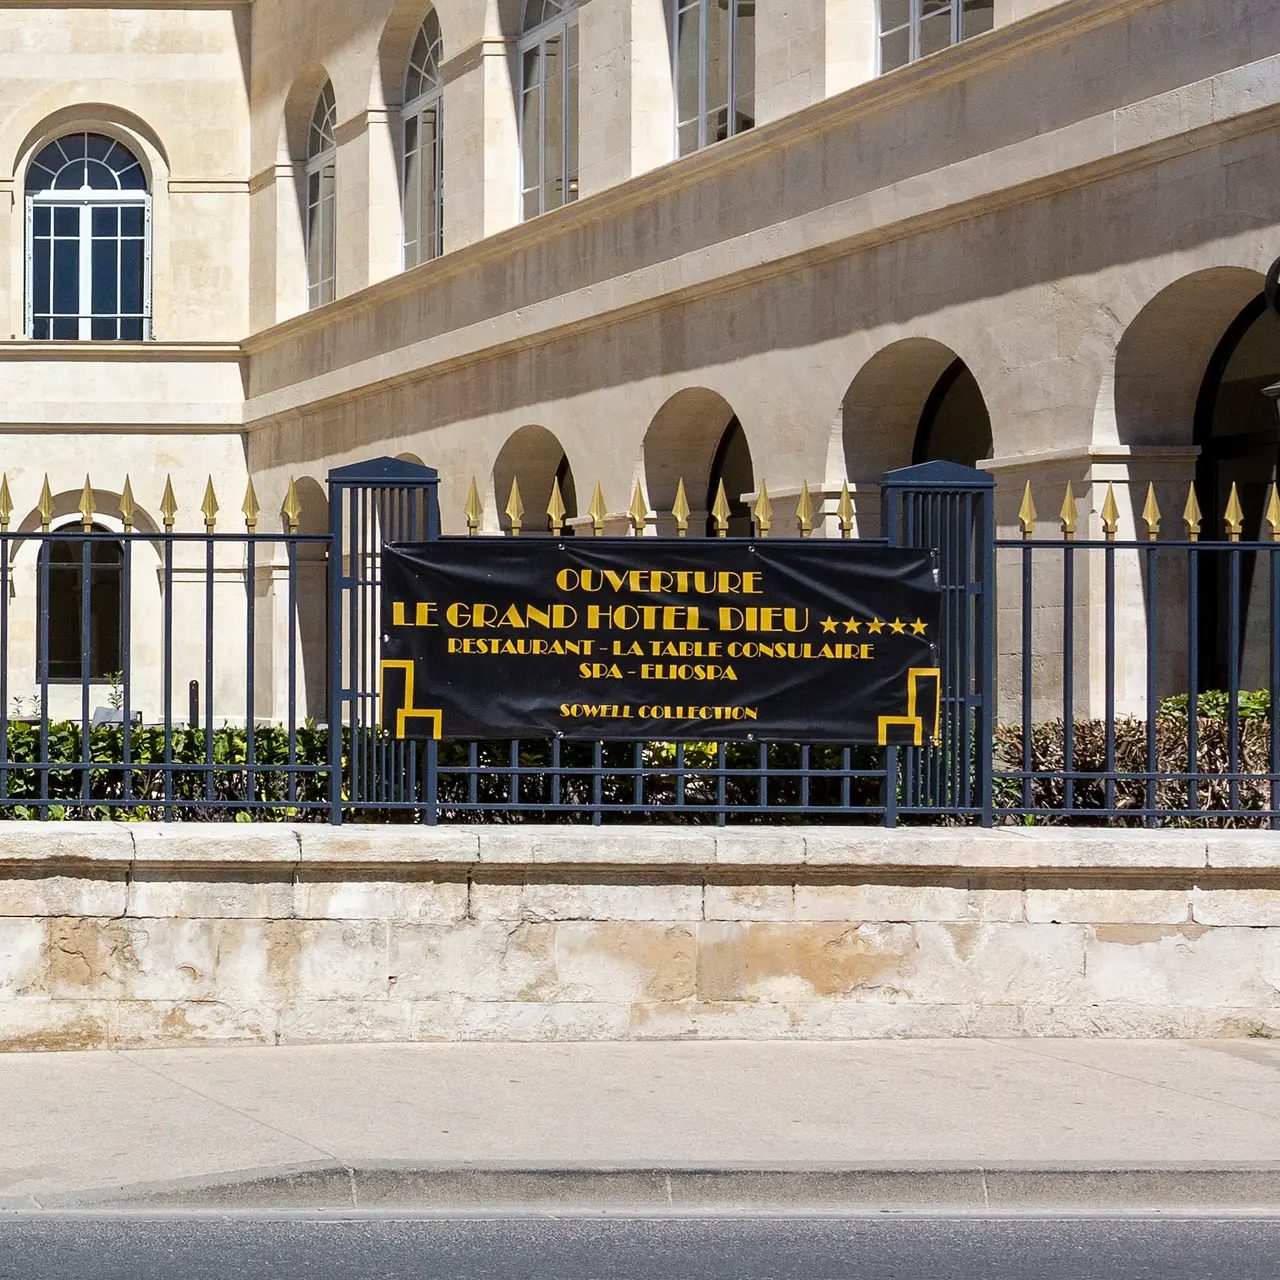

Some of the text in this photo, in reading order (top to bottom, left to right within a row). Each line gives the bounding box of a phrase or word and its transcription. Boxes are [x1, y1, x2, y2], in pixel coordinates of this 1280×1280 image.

[555, 568, 764, 594] OUVERTURE
[392, 601, 810, 633] LE GRAND HOTEL DIEU
[447, 637, 595, 656] RESTAURANT
[612, 640, 645, 657] LA
[648, 640, 723, 658] TABLE
[726, 641, 875, 660] CONSULAIRE
[579, 662, 624, 679] SPA
[641, 663, 738, 681] ELIOSPA
[559, 703, 758, 720] SOWELL COLLECTION
